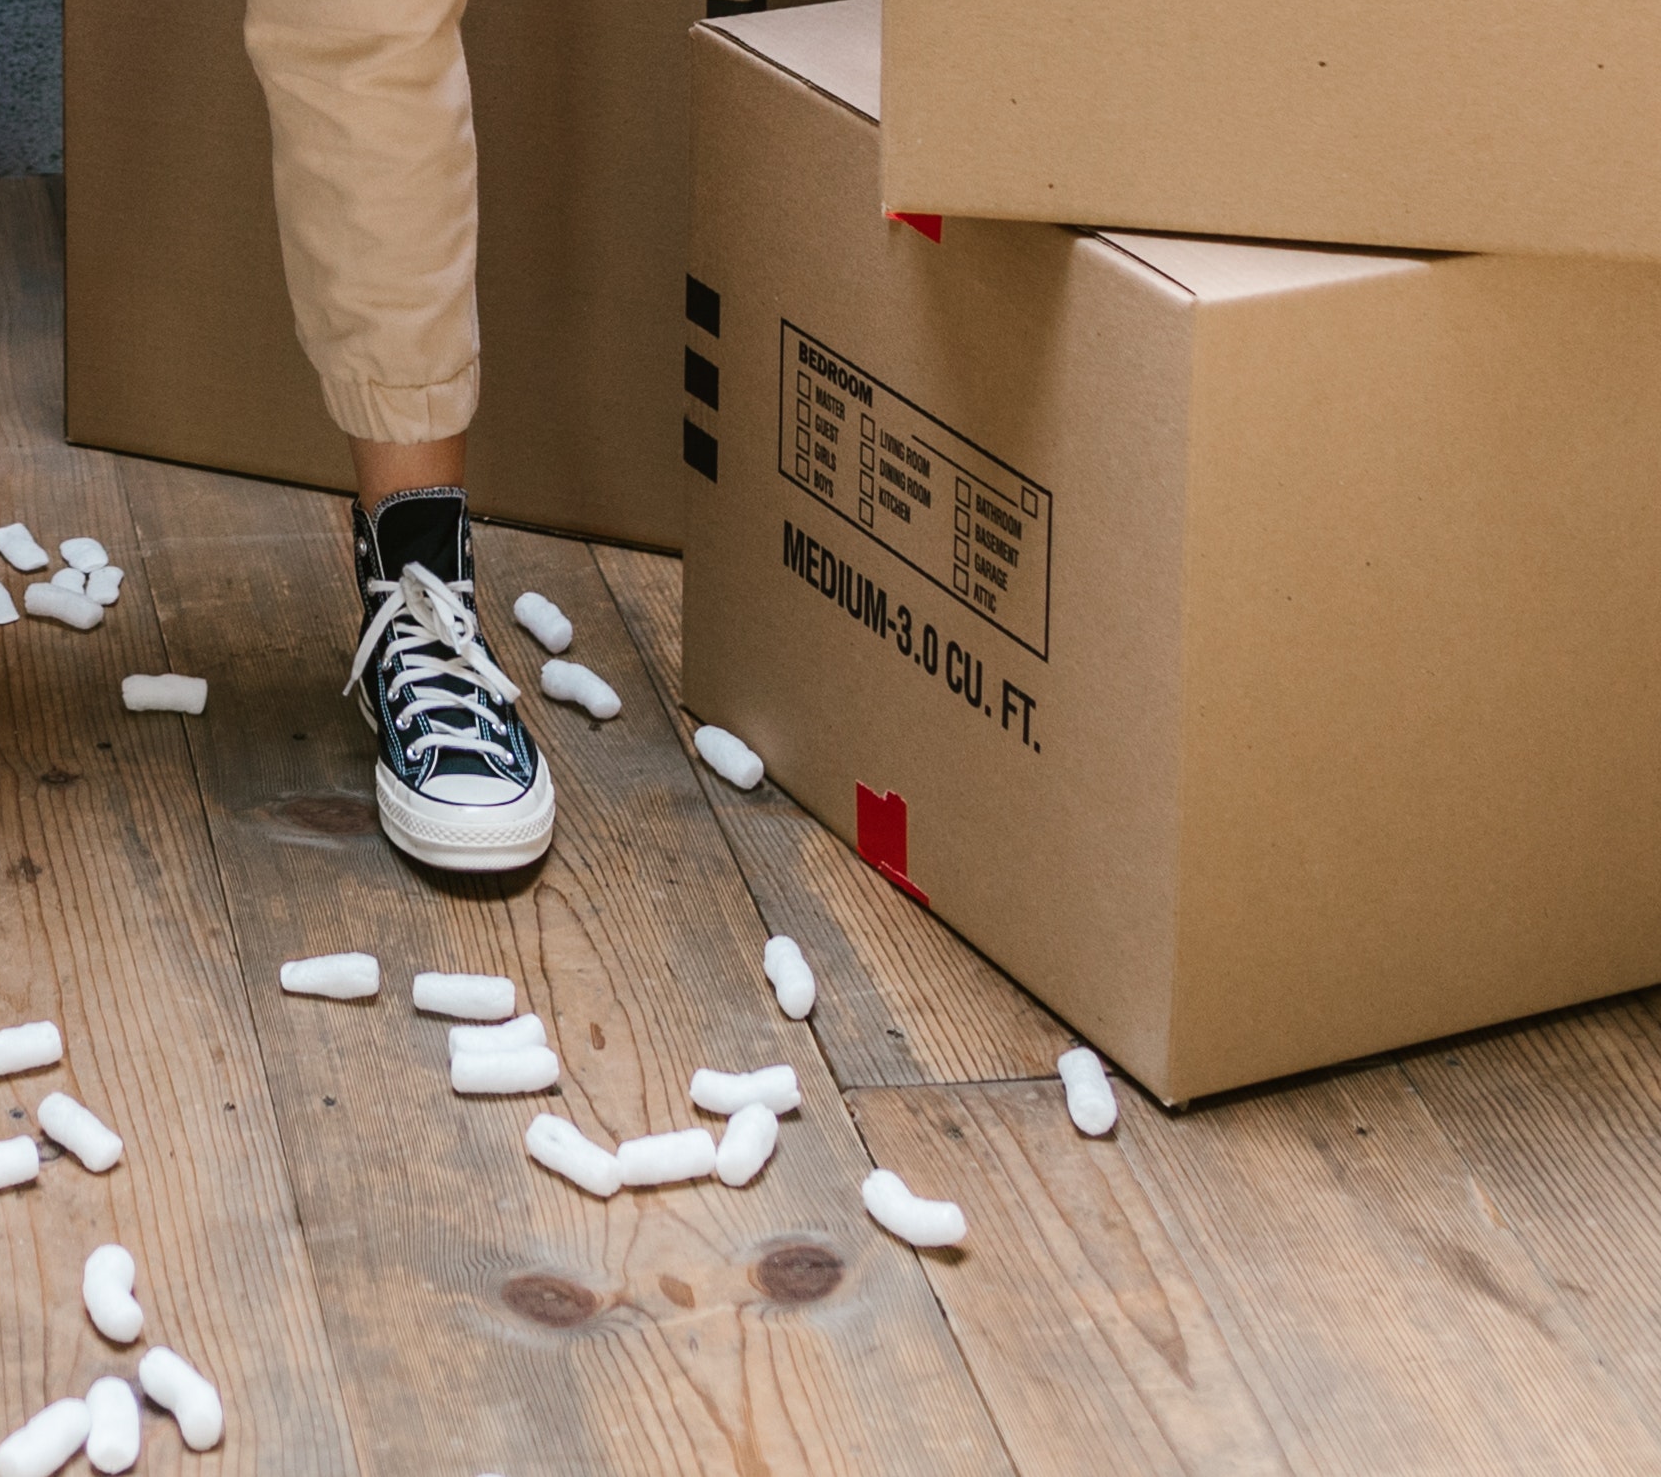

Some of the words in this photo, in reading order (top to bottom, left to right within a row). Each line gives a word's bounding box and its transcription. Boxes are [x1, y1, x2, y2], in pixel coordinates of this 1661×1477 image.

[798, 340, 873, 408] BEDROOM
[815, 385, 845, 422] MASTER
[815, 414, 839, 445] GUEST
[814, 442, 836, 472] GIRLS
[880, 428, 905, 462] LIVING
[906, 446, 930, 479] ROOM
[814, 469, 834, 498] BOYS
[879, 458, 906, 491] DINING
[907, 476, 931, 509] ROOM
[879, 485, 911, 524] KITCHEN
[975, 493, 1022, 541] BATHROOM
[975, 522, 1019, 568] BASEMENT
[974, 552, 1008, 592] GARAGE
[973, 582, 997, 614] ATTIC
[783, 519, 938, 676] MEDIUM-3.0
[945, 640, 992, 718] CU.
[1001, 678, 1041, 754] FT.
